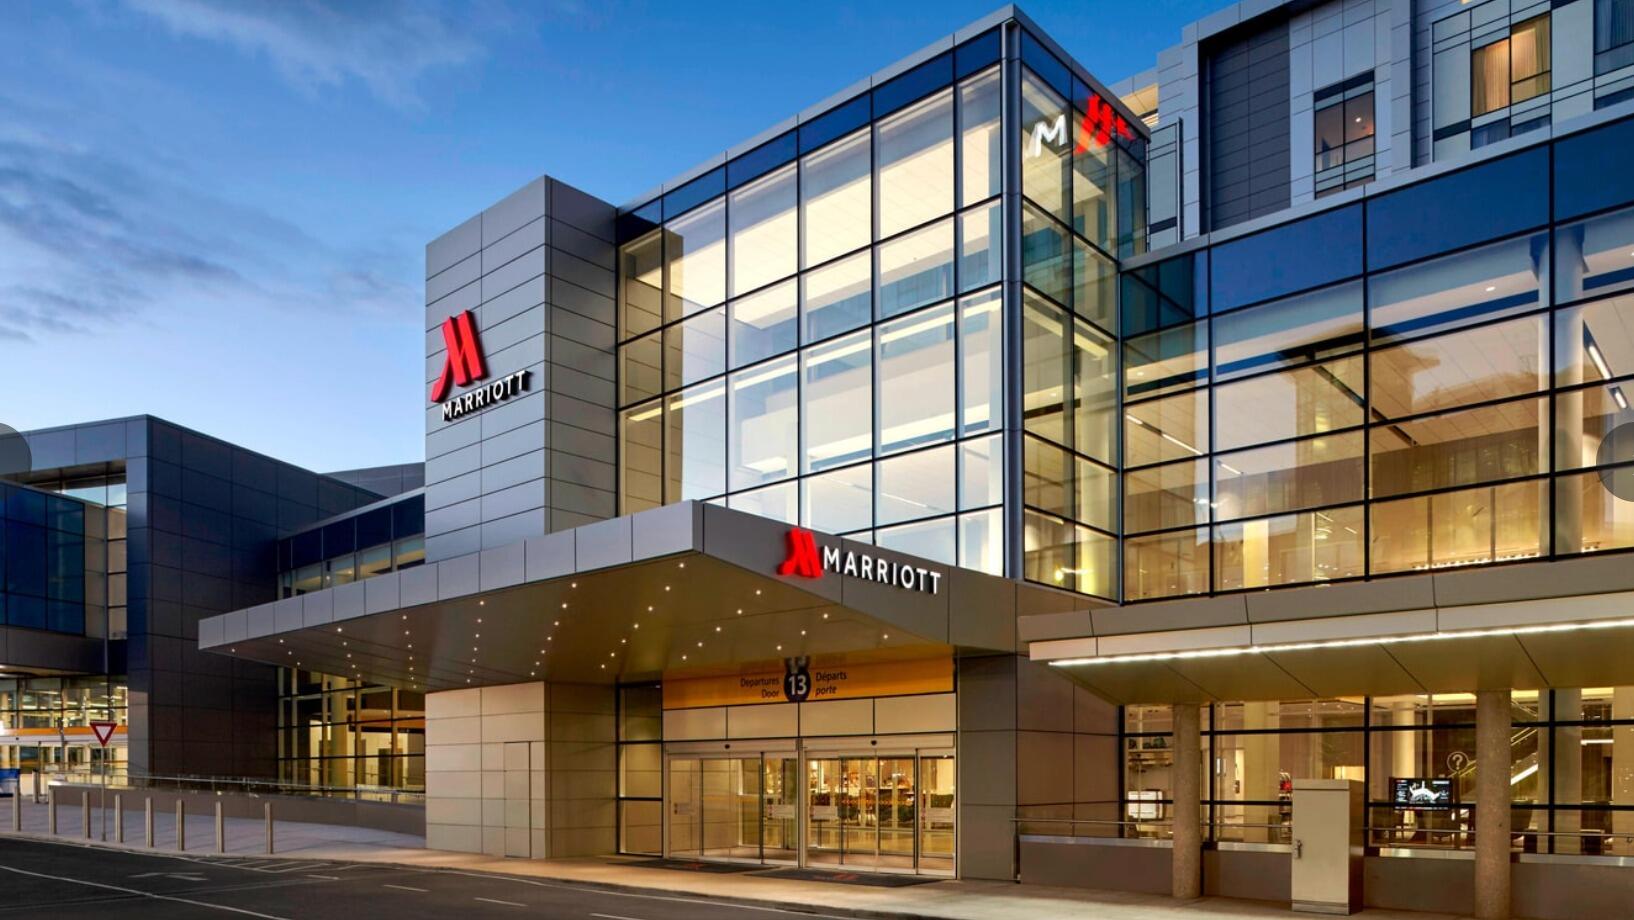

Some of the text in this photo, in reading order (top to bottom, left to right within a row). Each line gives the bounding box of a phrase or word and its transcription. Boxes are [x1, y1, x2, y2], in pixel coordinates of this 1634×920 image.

[442, 370, 529, 421] MARRIOTT
[823, 545, 942, 595] MARRIOTT
[788, 674, 807, 696] 13
[815, 671, 848, 682] Départs
[761, 688, 779, 698] Door
[815, 685, 837, 697] porte
